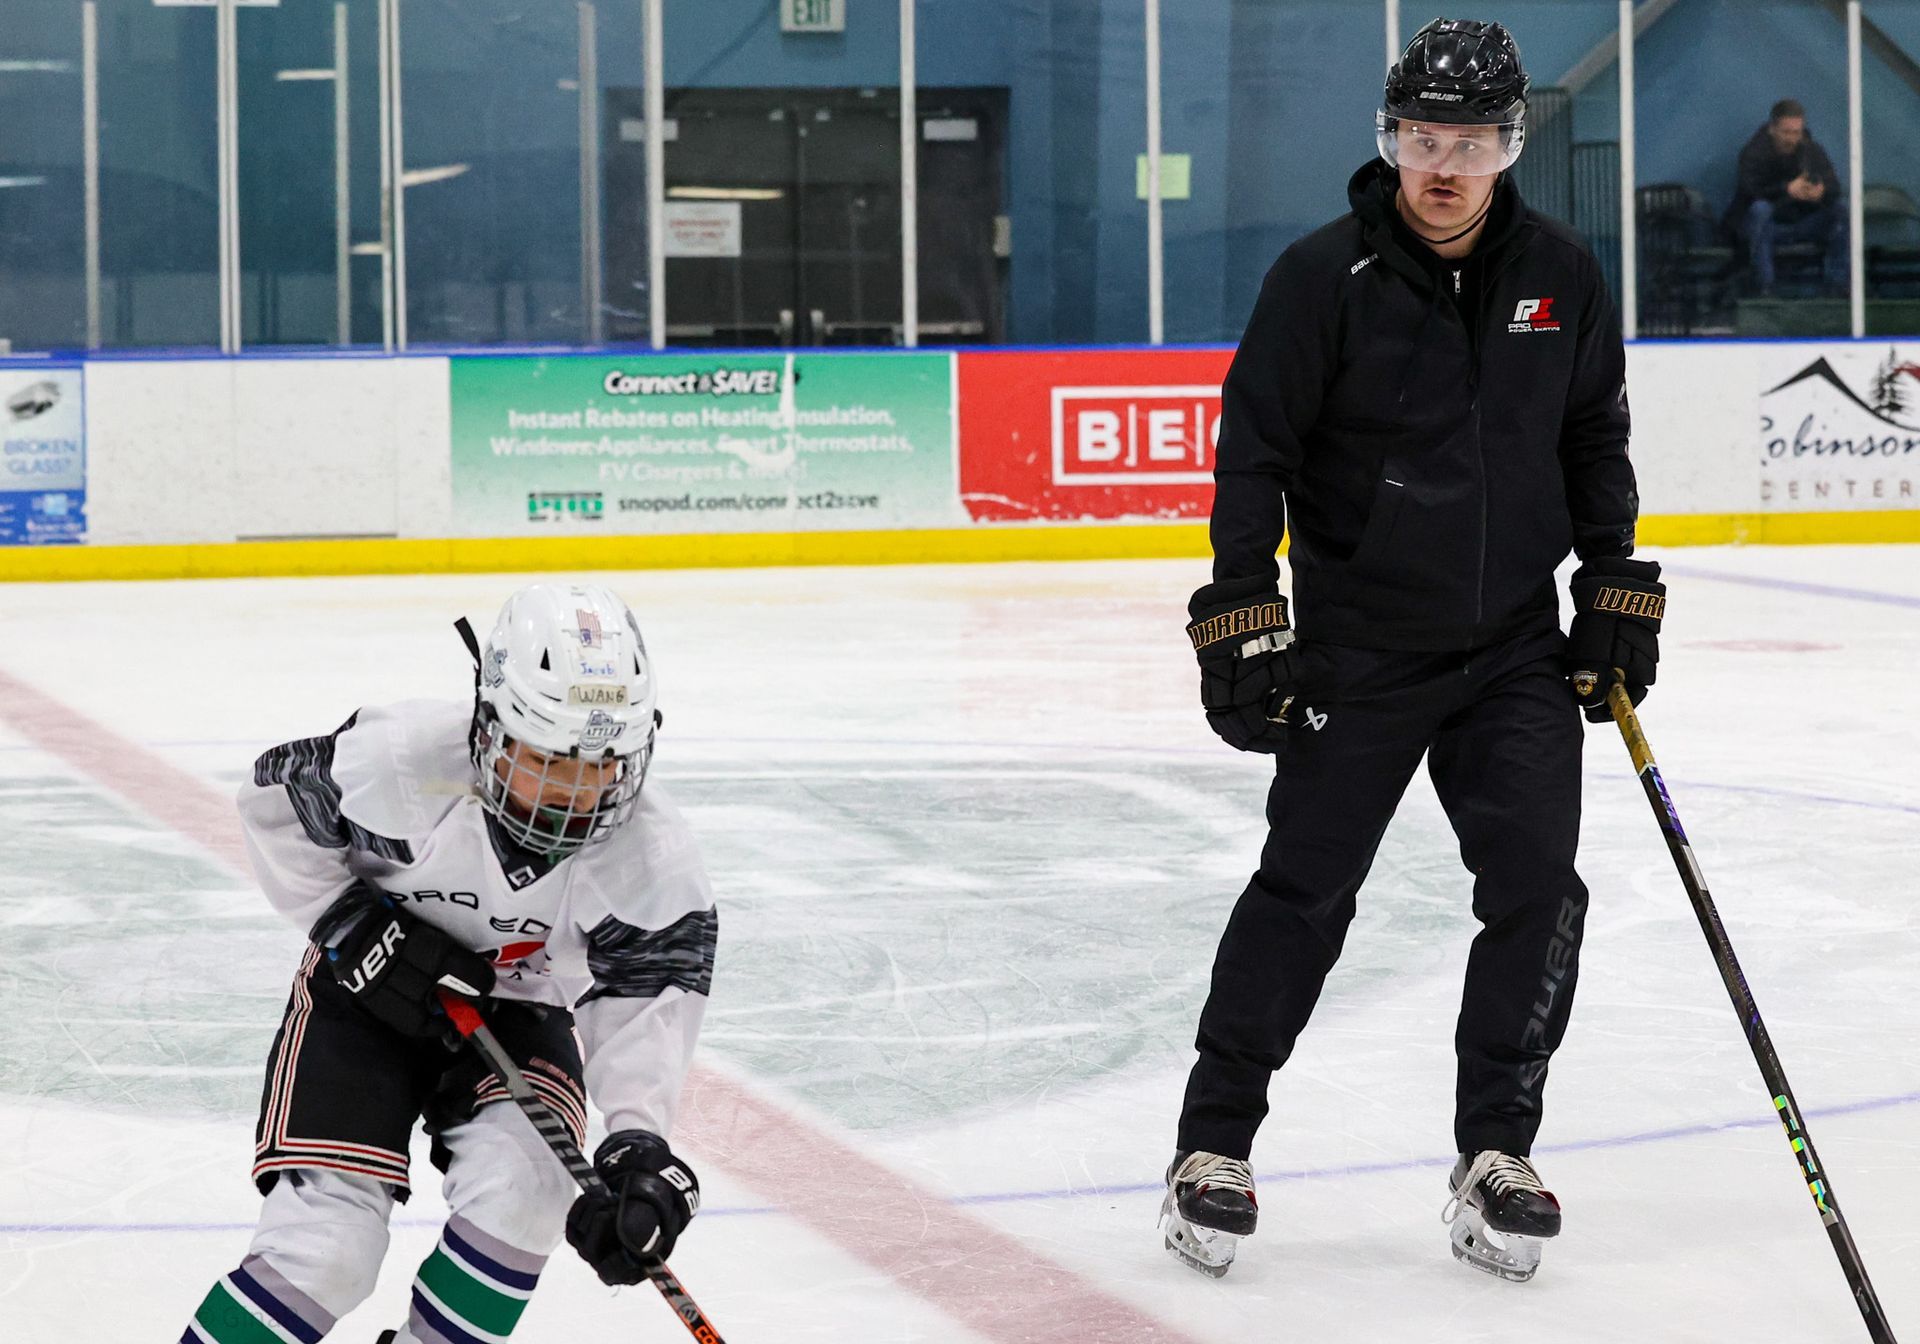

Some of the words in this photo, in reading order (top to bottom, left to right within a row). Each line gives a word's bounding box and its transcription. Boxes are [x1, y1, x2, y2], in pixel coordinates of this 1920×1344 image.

[603, 370, 697, 395] Connect
[508, 409, 581, 429] Instant
[585, 407, 668, 428] Rebates
[672, 411, 699, 428] on
[1189, 602, 1288, 651] WARRIOR
[341, 920, 406, 994] UER
